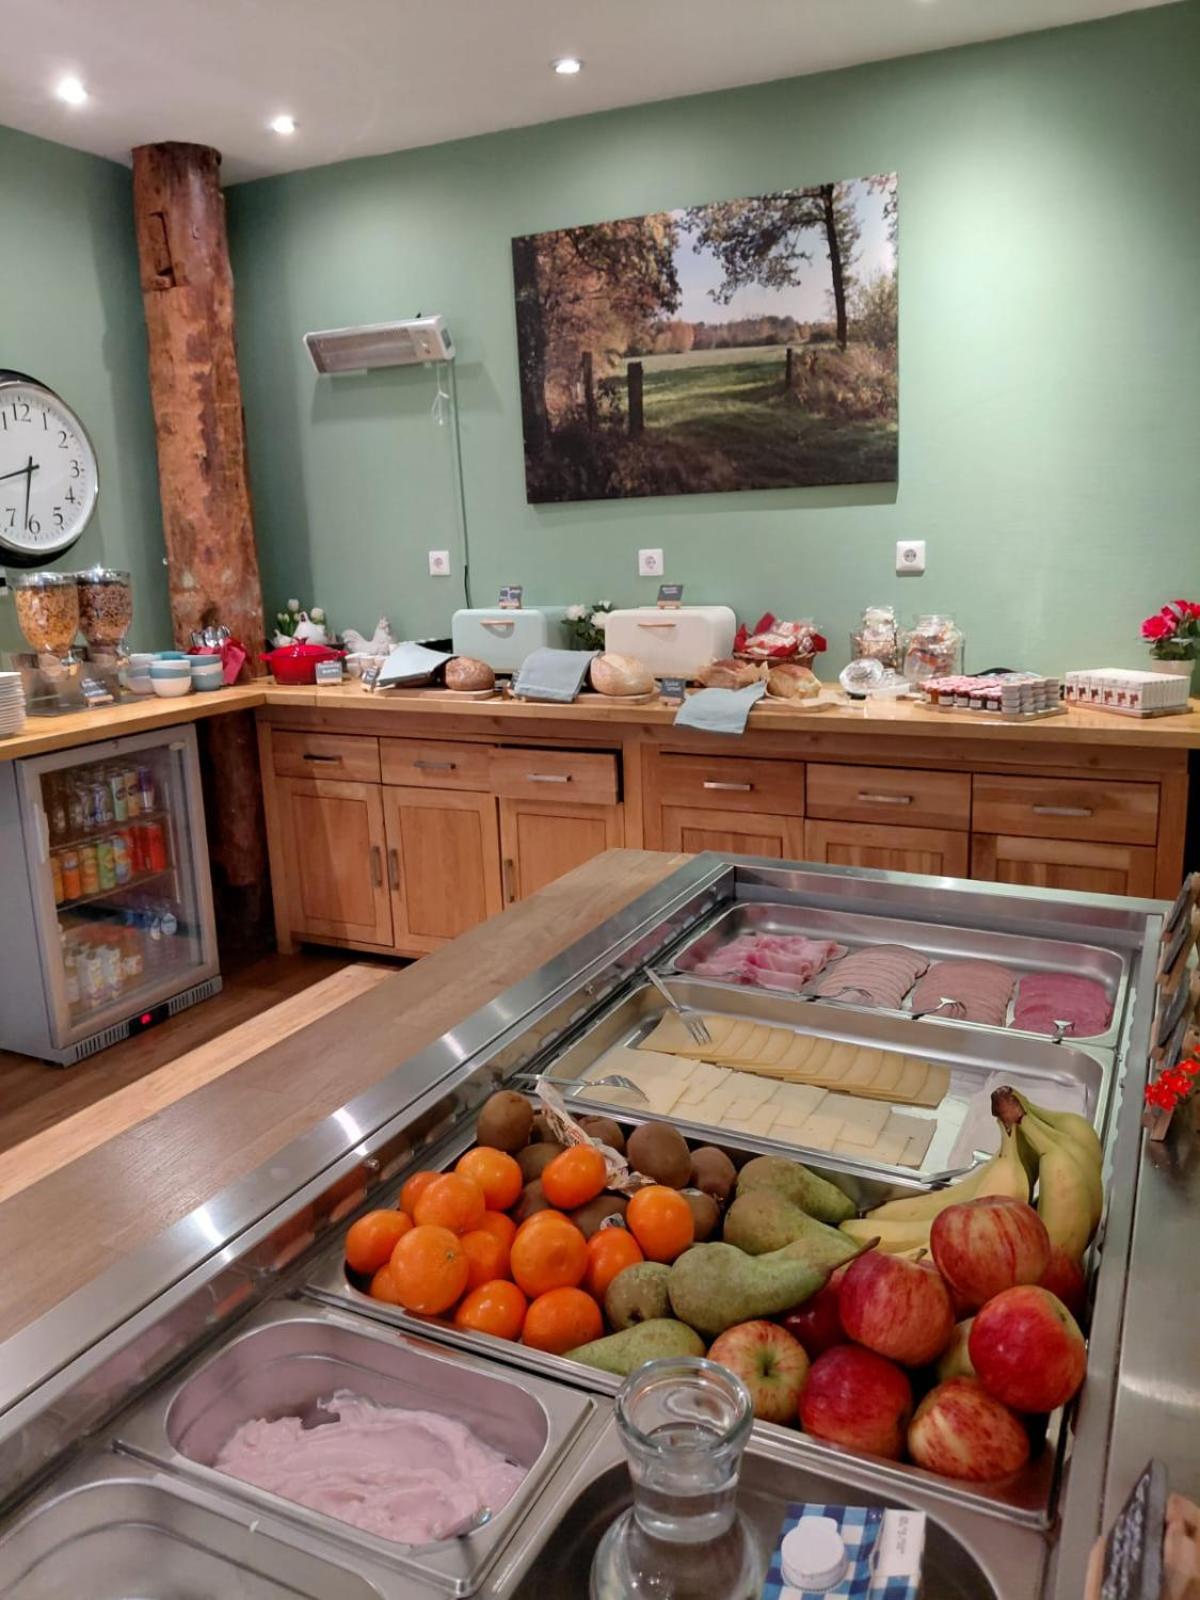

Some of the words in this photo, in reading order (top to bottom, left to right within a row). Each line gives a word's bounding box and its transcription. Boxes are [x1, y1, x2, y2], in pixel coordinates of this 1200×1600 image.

[12, 402, 31, 422] 12
[42, 412, 48, 430] 1
[58, 430, 68, 448] 2
[70, 459, 80, 478] 3
[65, 486, 76, 503] 4
[5, 508, 16, 527] 7
[28, 513, 41, 535] 6
[53, 507, 64, 526] 5
